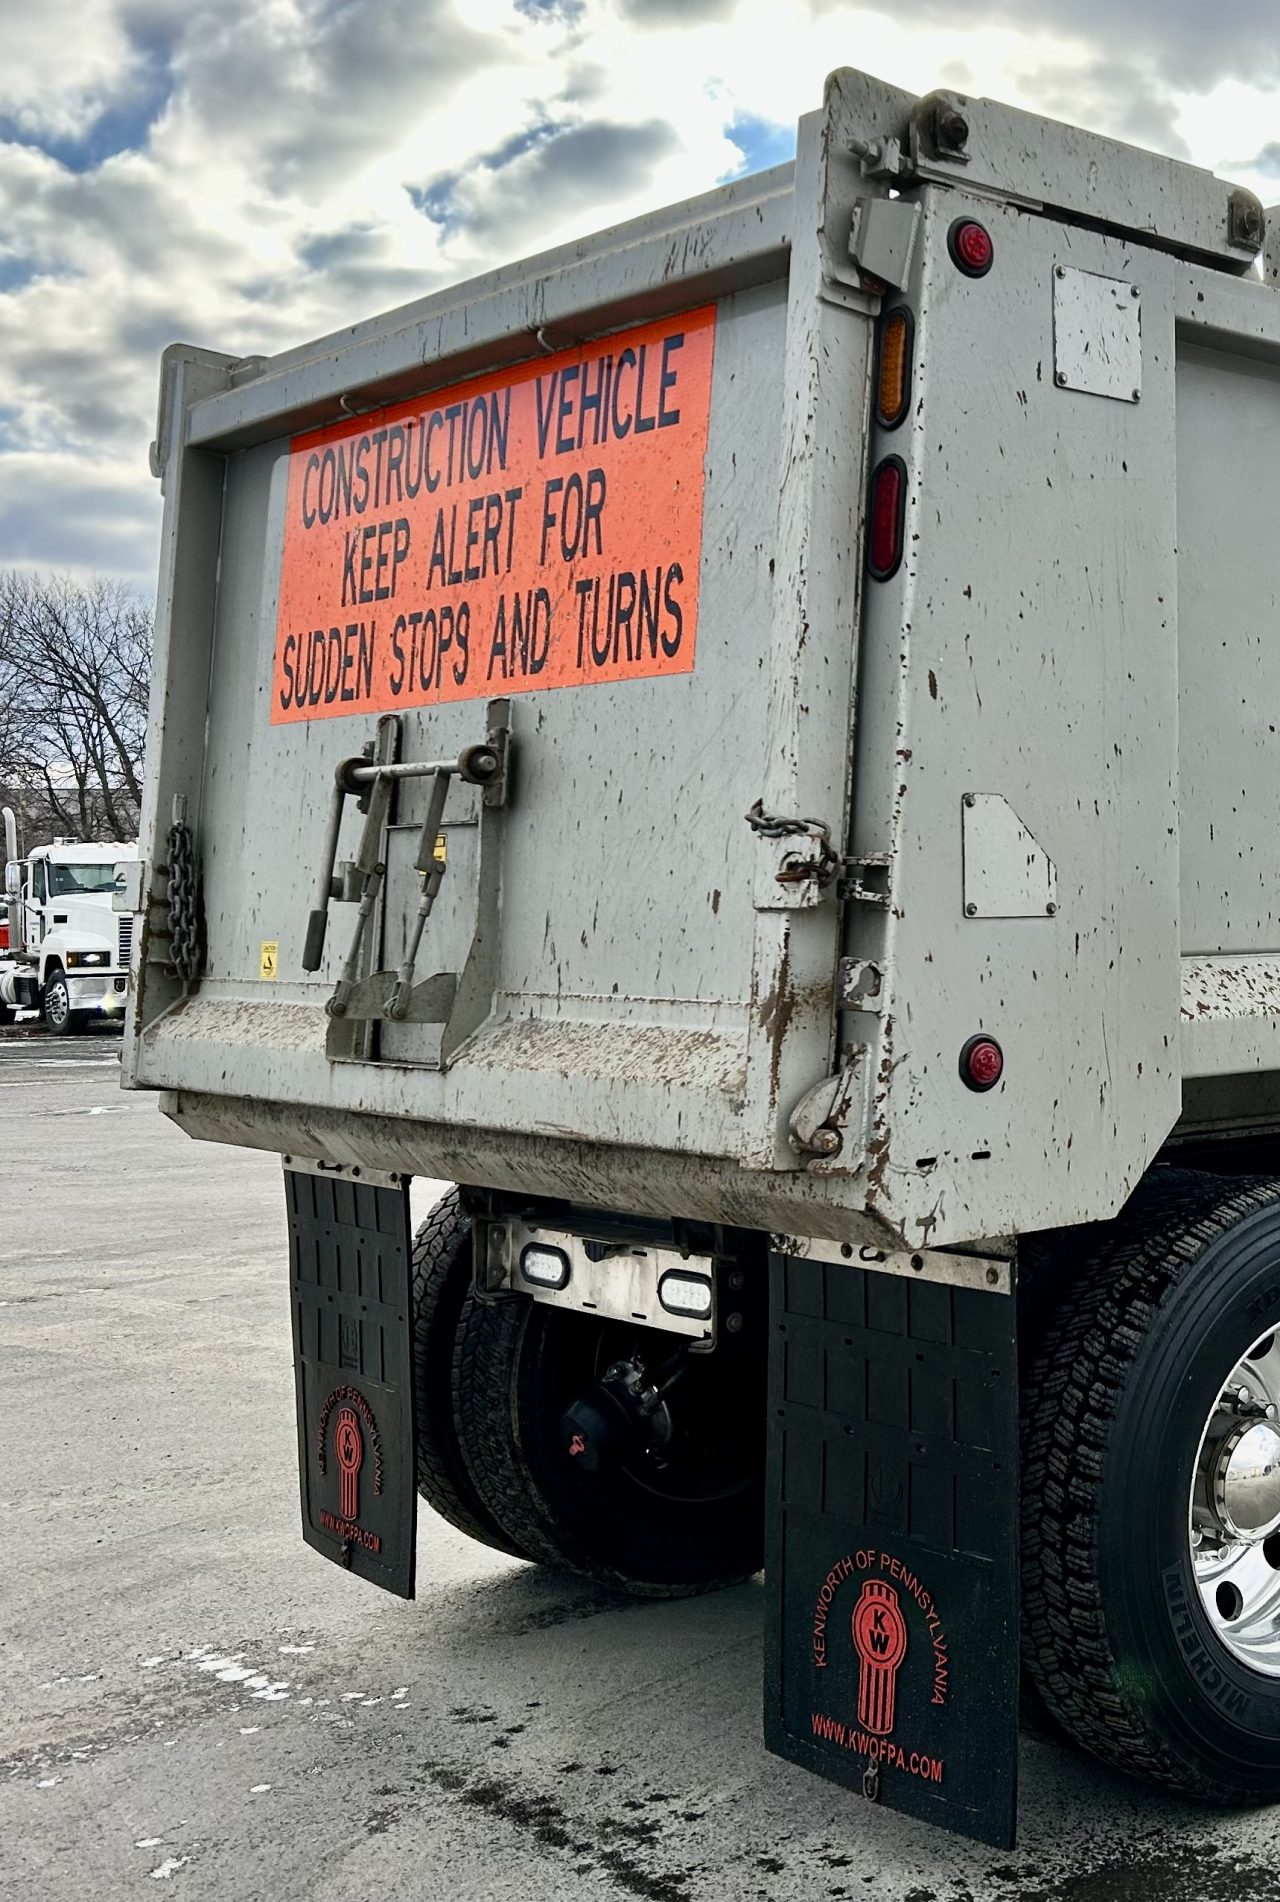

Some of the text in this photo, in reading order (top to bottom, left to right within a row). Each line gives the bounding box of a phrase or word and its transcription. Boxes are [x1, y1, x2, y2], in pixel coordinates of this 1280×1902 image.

[302, 333, 685, 529] CONSTRUCTION VEHICLE
[341, 467, 606, 607] KEEP ALERT FOR
[280, 562, 685, 710] SUDDEN STOPS AND TURNS
[343, 1445, 353, 1463] W
[344, 1429, 351, 1446] K
[812, 1550, 948, 1705] KENWORTH OF PENNSYLVANIA
[869, 1631, 889, 1655] W
[873, 1610, 887, 1633] K
[1165, 1573, 1253, 1717] MICHELIN
[811, 1713, 943, 1783] WWW.KWOFPA.COM
